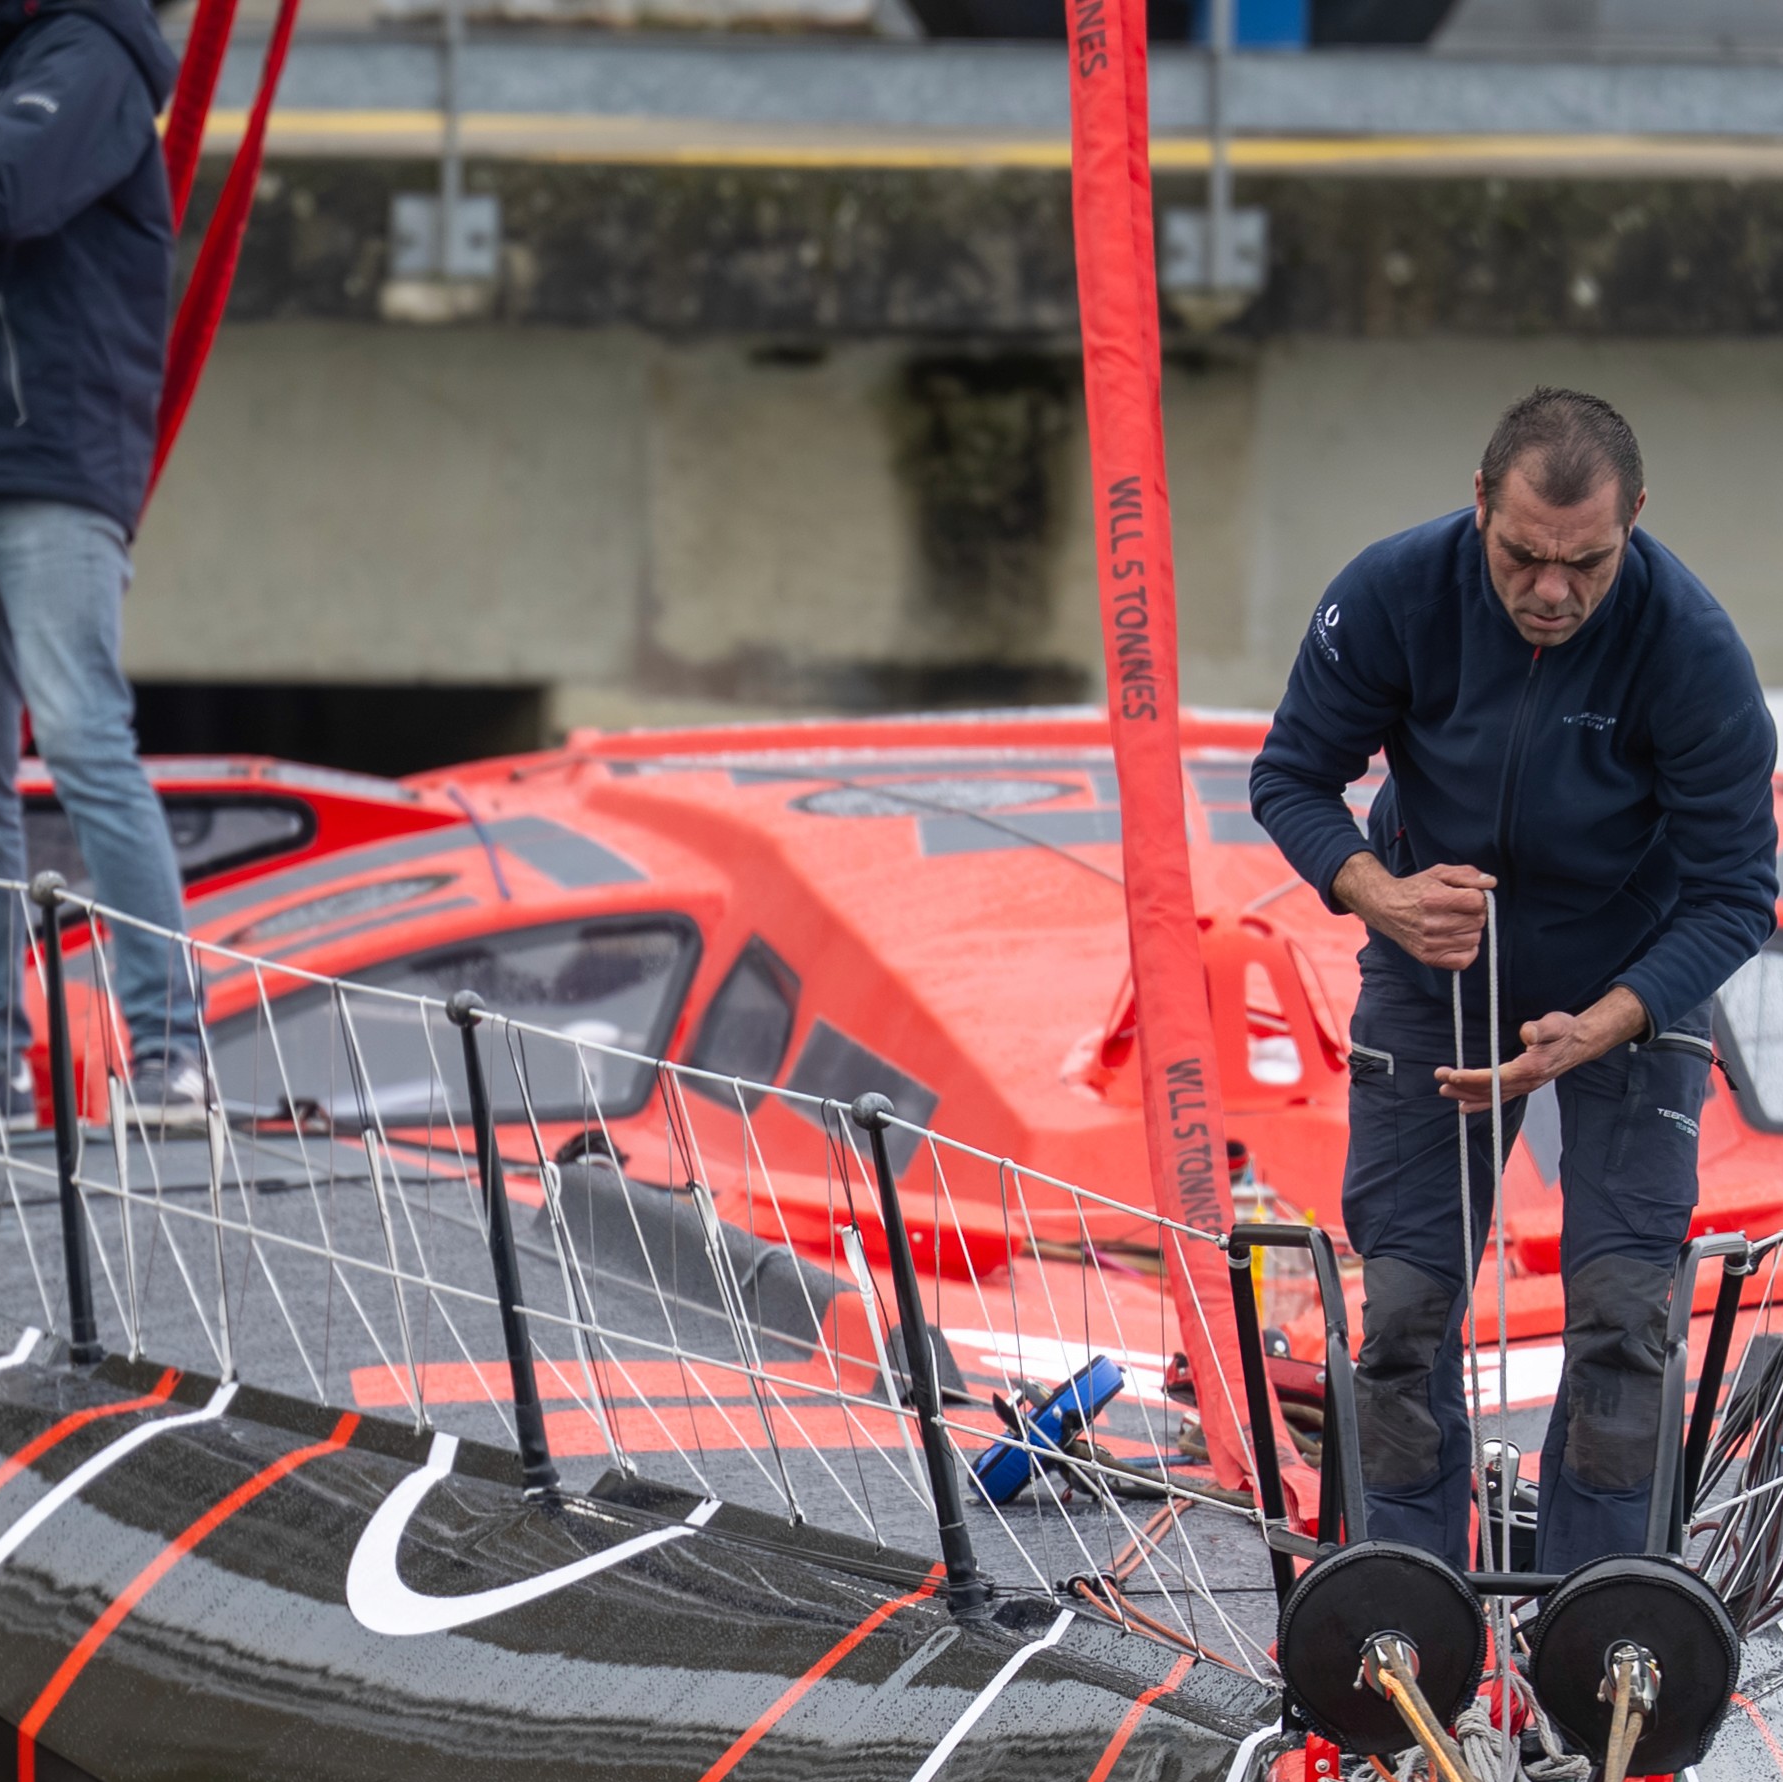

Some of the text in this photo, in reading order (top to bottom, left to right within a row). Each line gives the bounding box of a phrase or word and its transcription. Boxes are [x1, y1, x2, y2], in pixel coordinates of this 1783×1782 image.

[1075, 0, 1108, 78] NES
[1108, 475, 1157, 722] WLL 5 TONNES
[1166, 1058, 1206, 1120] WLL
[1173, 1122, 1209, 1140] 5
